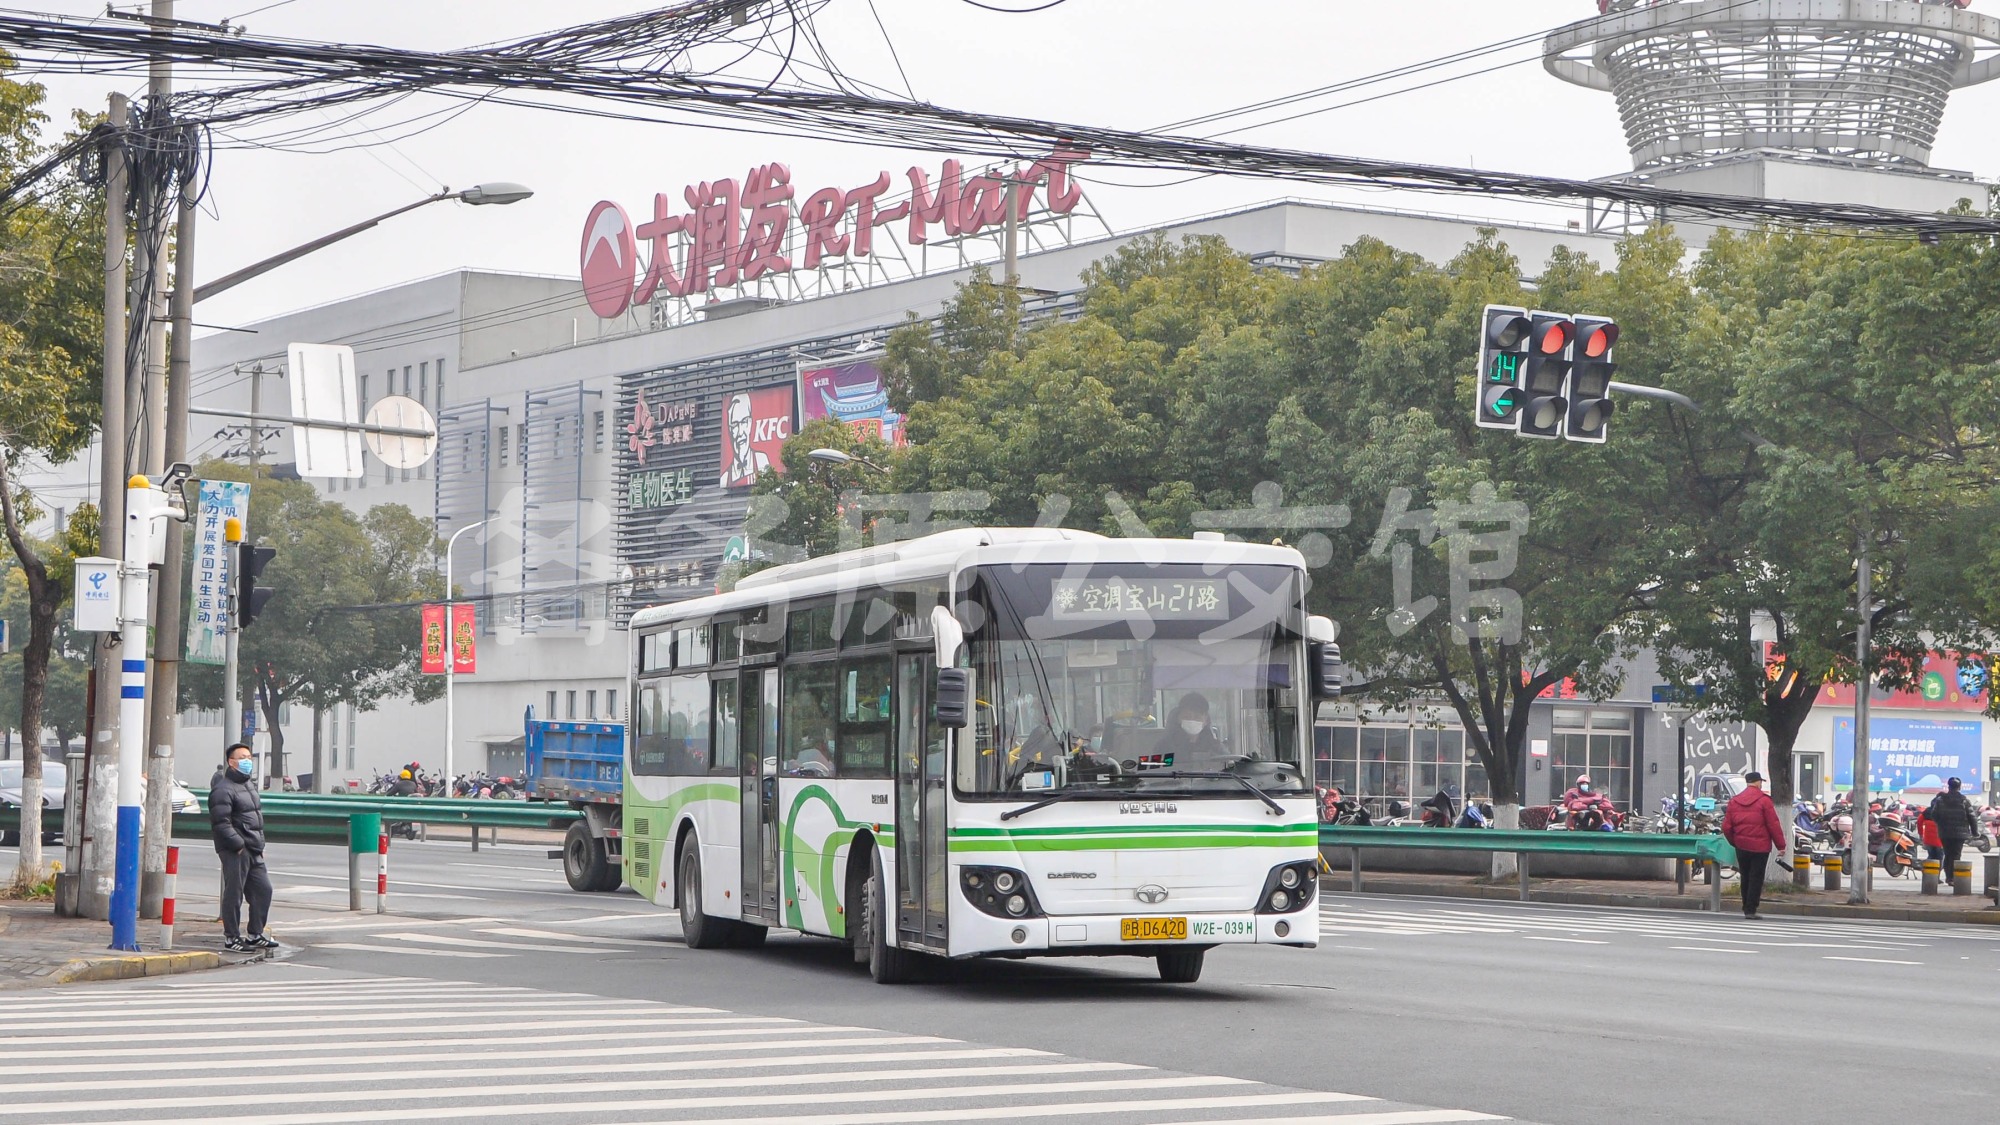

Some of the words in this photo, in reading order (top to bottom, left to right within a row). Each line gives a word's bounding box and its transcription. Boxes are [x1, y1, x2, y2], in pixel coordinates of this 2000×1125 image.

[634, 162, 794, 305] 大润发
[800, 137, 1091, 270] RT-Mart
[753, 415, 789, 443] KFC
[627, 468, 694, 511] 植物医生
[197, 490, 221, 623] 大力开展爱国卫生运动
[1082, 584, 1220, 612] 空调宝山21路
[1047, 871, 1097, 879] DAEWOO
